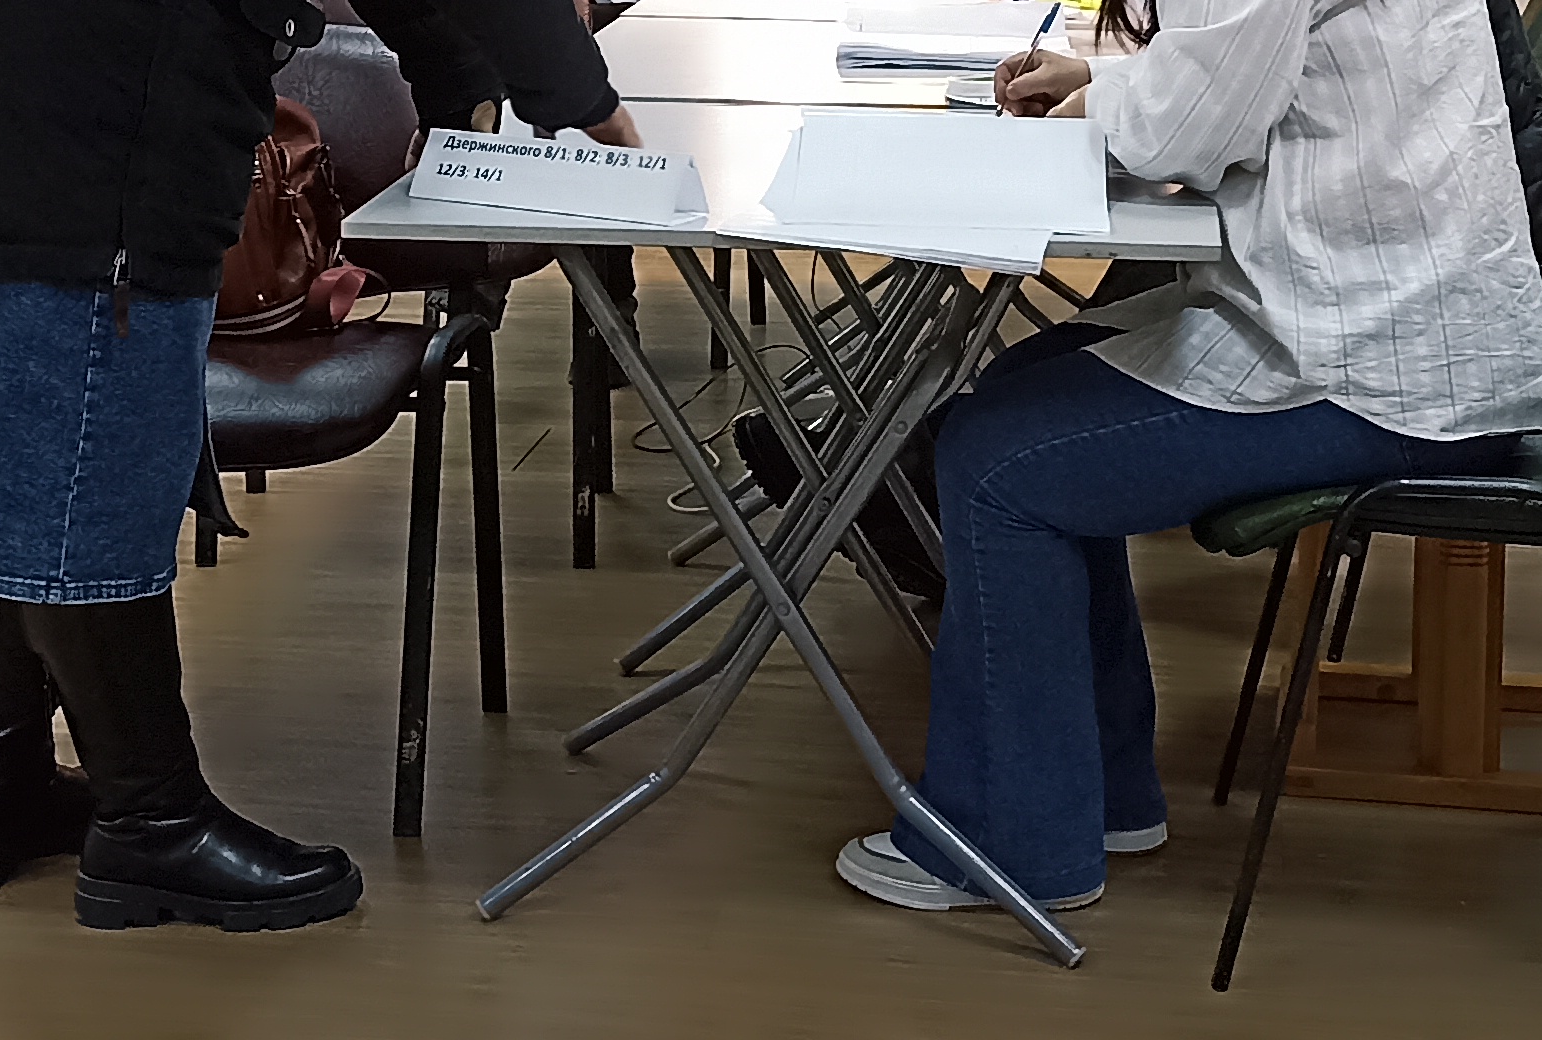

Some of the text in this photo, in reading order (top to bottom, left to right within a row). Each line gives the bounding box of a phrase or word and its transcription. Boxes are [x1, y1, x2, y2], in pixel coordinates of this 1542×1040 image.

[443, 135, 542, 158] Дзержинского
[544, 145, 571, 161] 8/1;
[574, 148, 602, 165] 8/2;
[436, 163, 504, 182] 12/3; 14/1
